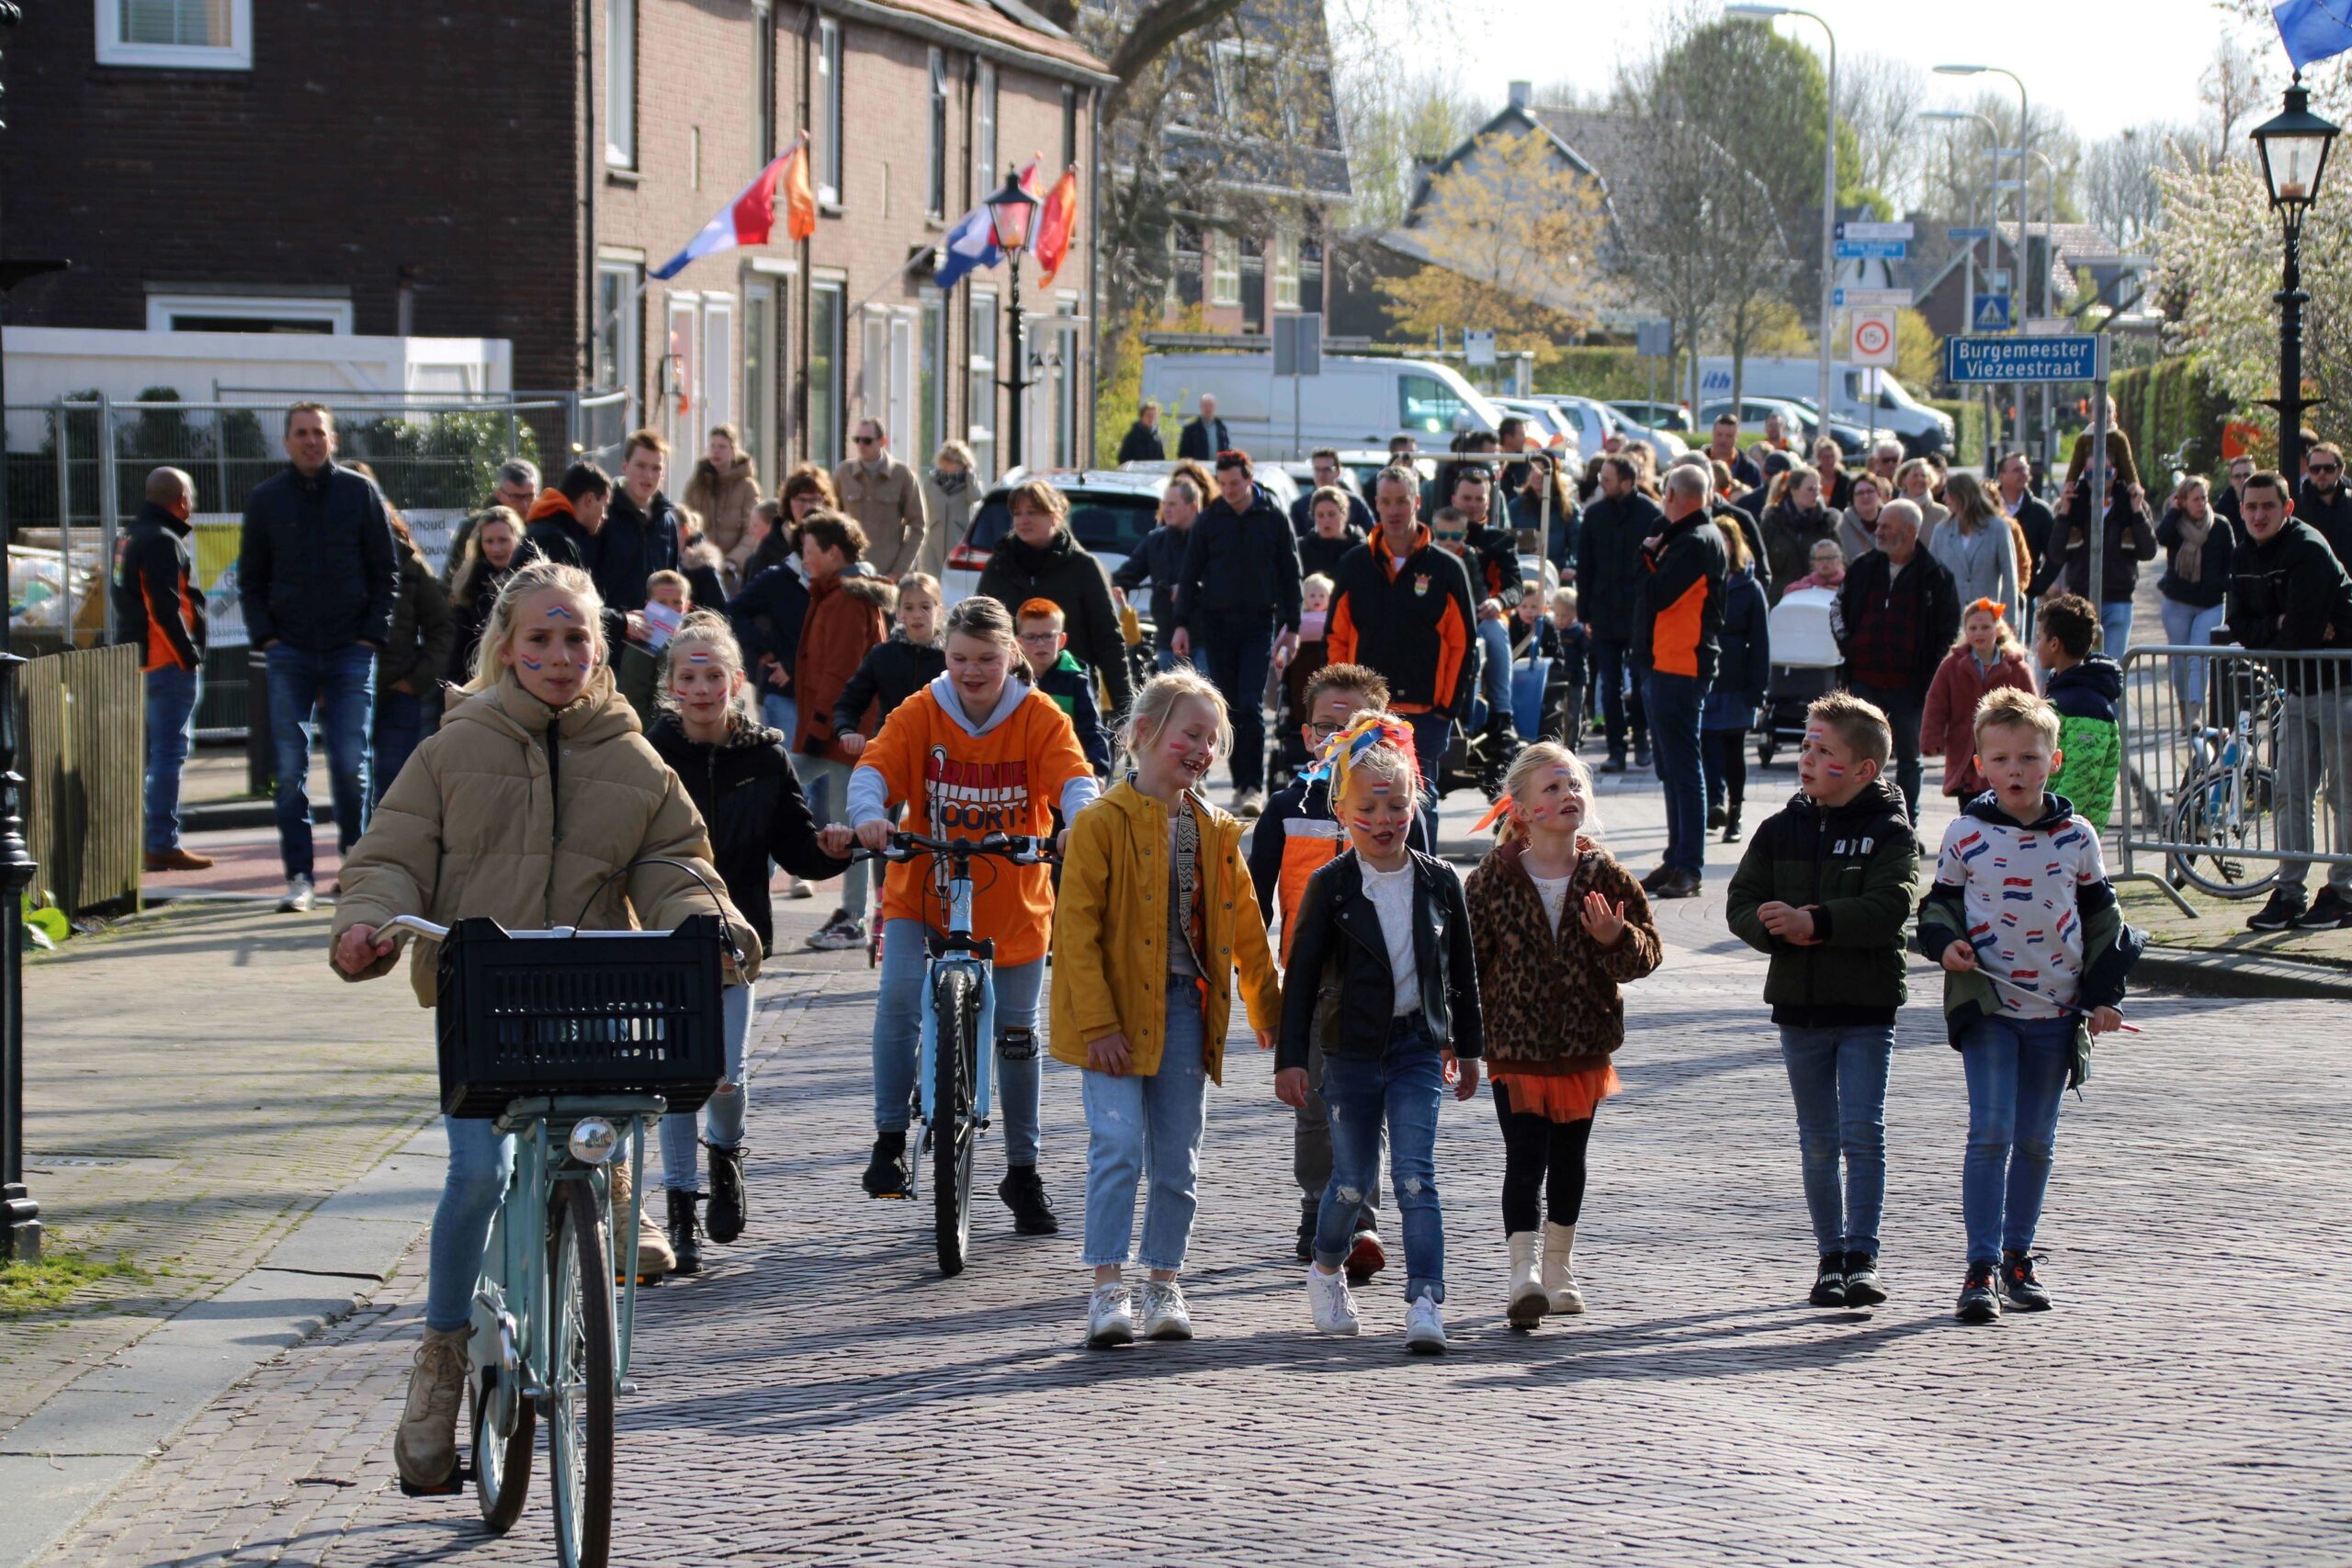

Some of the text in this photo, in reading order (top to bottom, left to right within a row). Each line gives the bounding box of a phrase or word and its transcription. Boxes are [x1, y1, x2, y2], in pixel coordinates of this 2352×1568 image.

[1959, 341, 2088, 363] Burgemeester
[1966, 359, 2082, 378] Viezeestraat
[924, 755, 1027, 803] ORANJE
